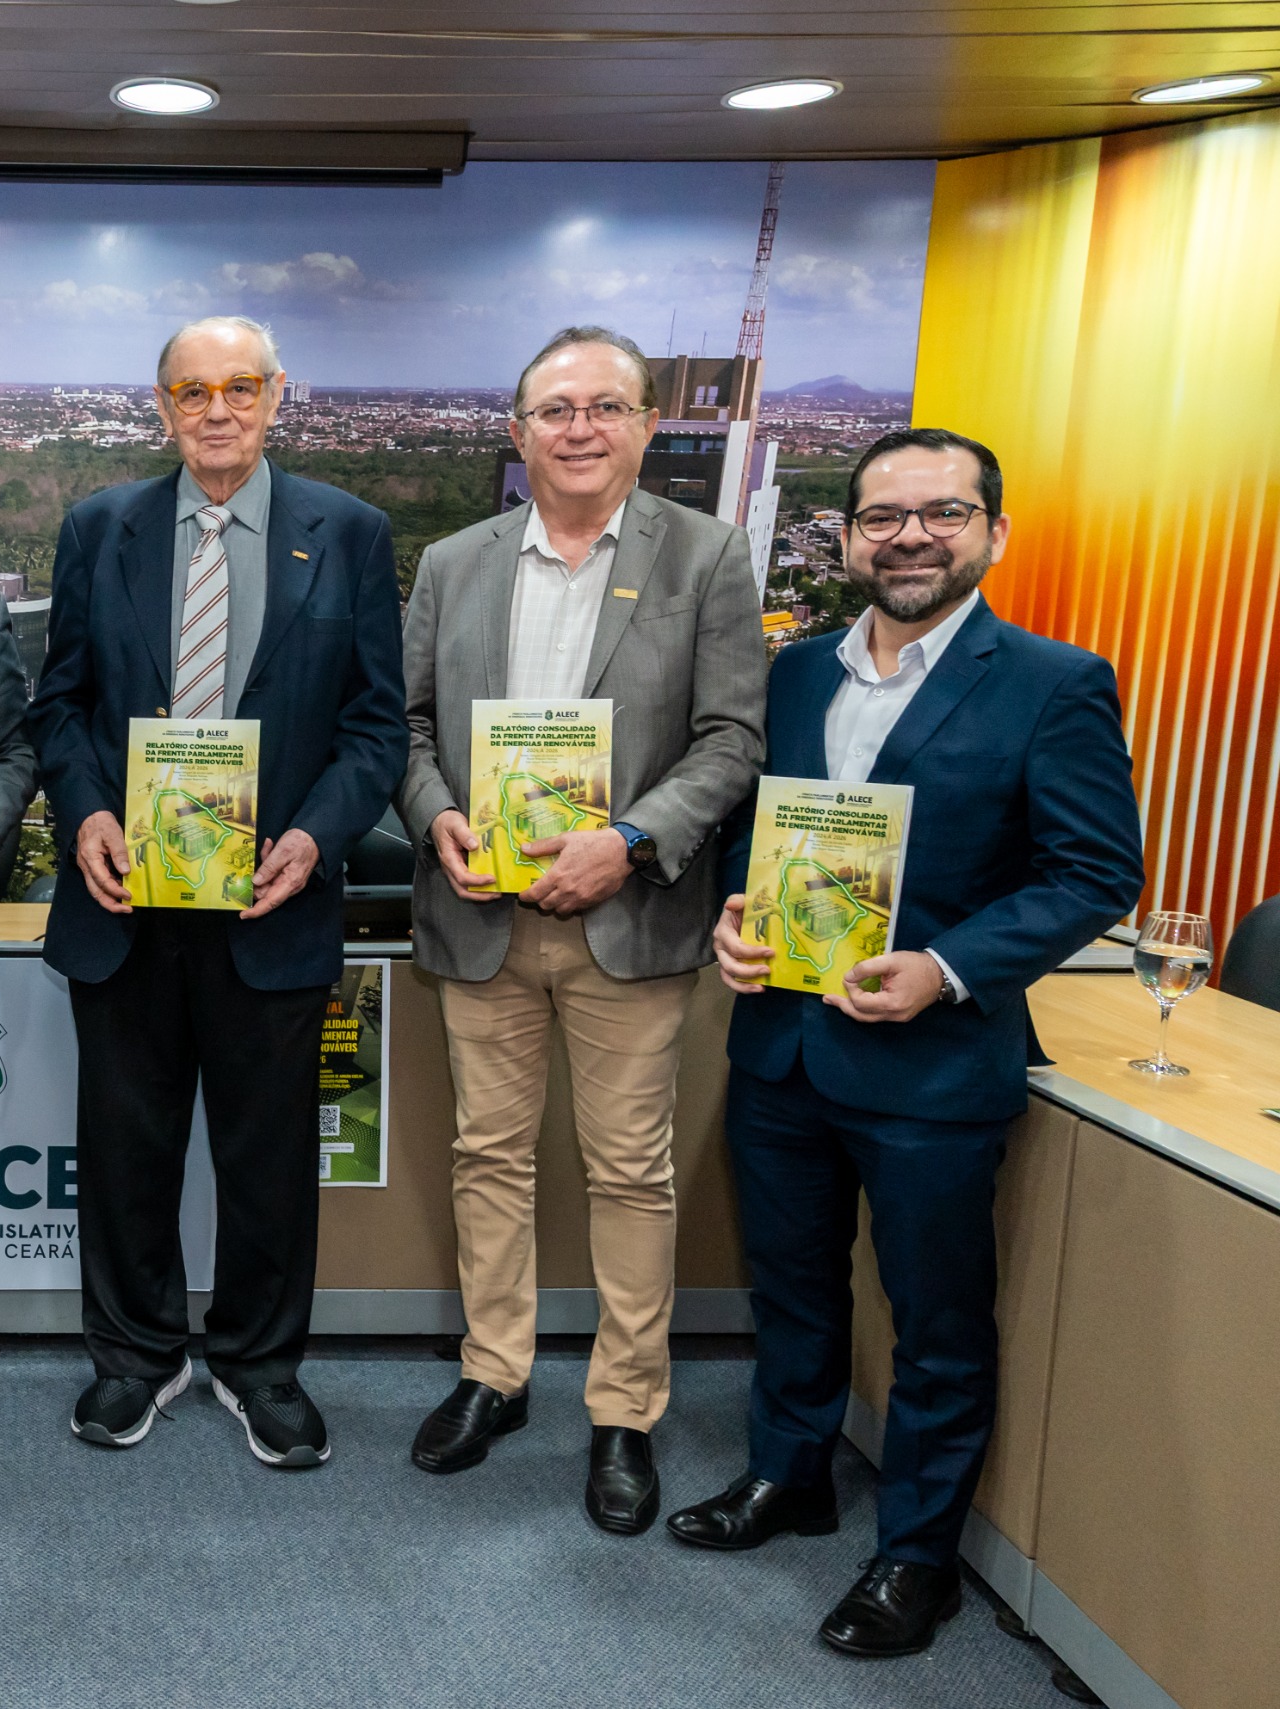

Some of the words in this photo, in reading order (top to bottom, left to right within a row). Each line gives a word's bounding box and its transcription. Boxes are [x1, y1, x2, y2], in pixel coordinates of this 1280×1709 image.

[848, 795, 873, 804] ALECE
[778, 805, 825, 816] RELATÓRIO
[827, 810, 888, 821] CONSOLIDADO
[790, 814, 822, 823] FRENTE
[824, 818, 887, 829] PARLAMENTAR
[788, 822, 830, 832] ENERGIAS
[832, 826, 886, 838] RENOVÁVEIS
[5, 1240, 74, 1258] CEARÁ
